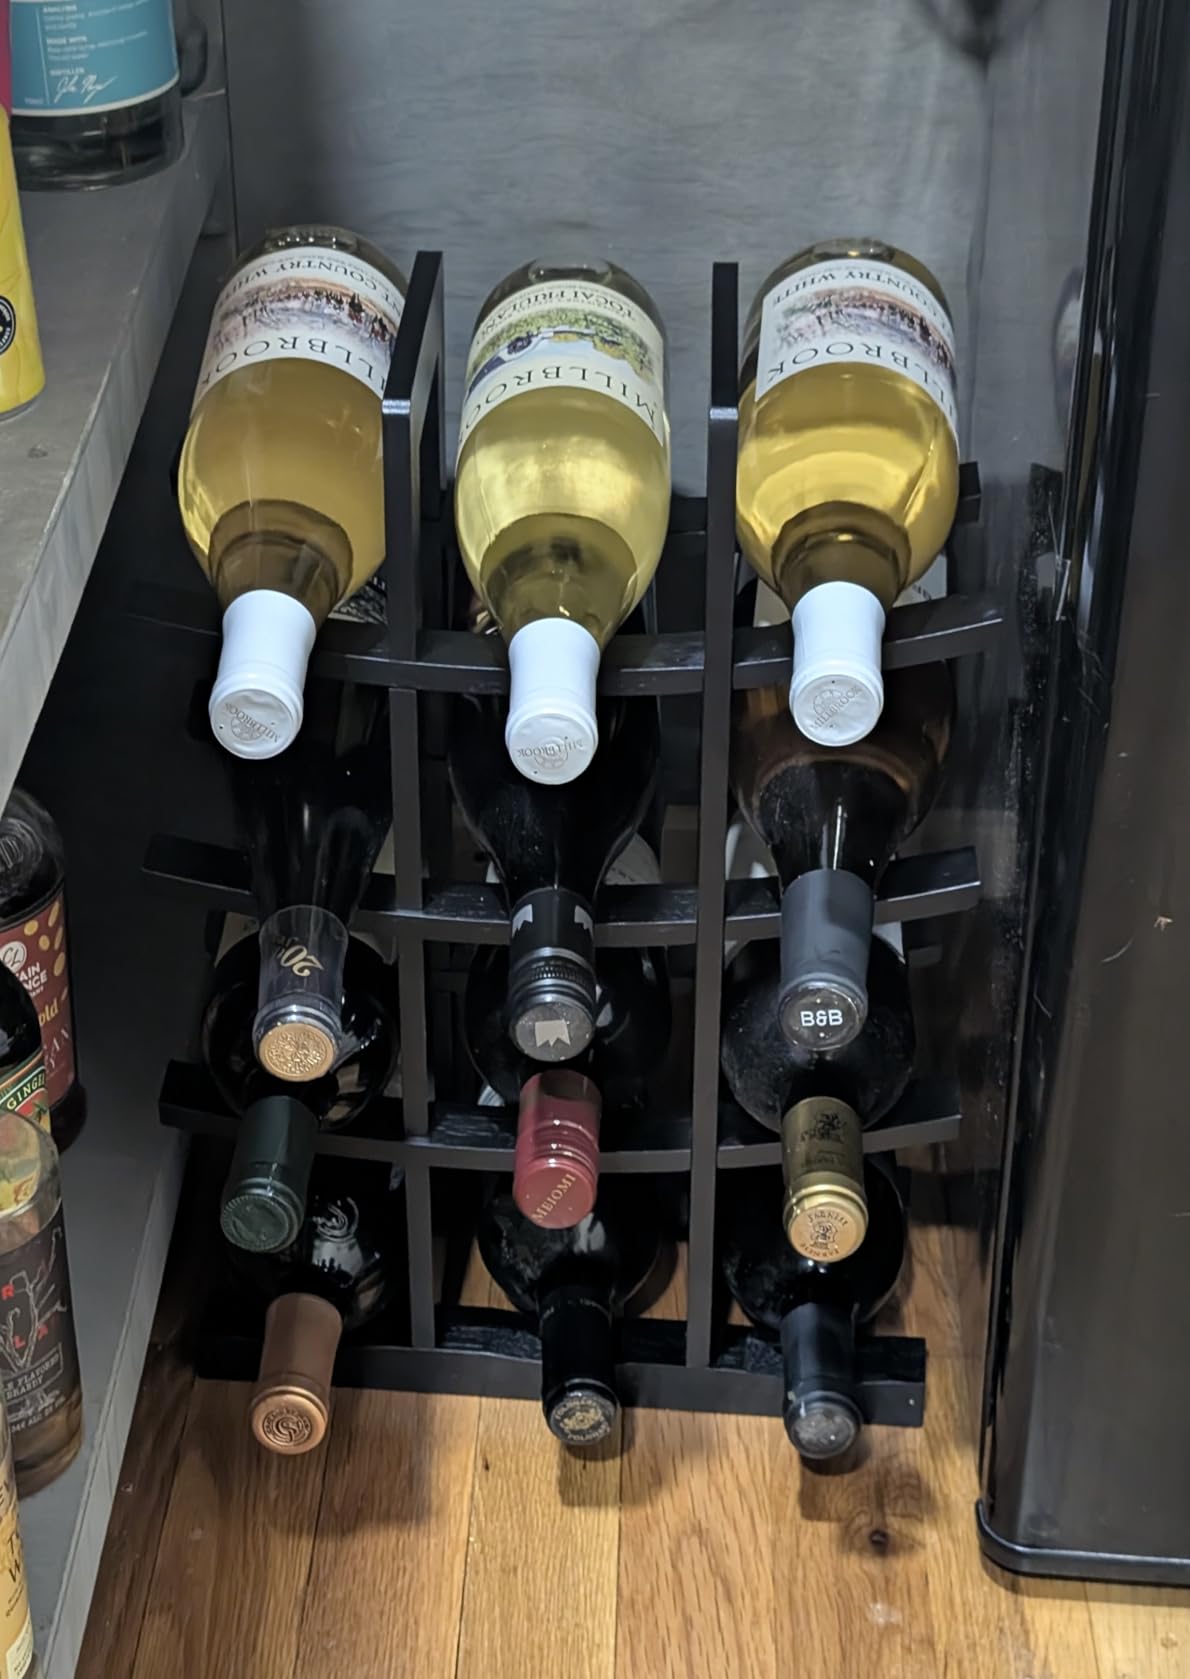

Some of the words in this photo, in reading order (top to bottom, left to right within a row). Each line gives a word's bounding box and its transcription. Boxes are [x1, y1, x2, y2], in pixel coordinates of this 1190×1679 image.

[279, 259, 377, 291] COUNTRY
[774, 272, 837, 304] WHITE
[201, 335, 386, 392] ILLBROOK
[767, 341, 954, 418] ILLBROOK
[224, 702, 280, 743] MILLBROOK
[810, 685, 862, 729] MILLBROOK
[800, 1008, 844, 1027] B&B
[6, 1072, 45, 1110] GINGE
[531, 1172, 577, 1223] MEIOMI
